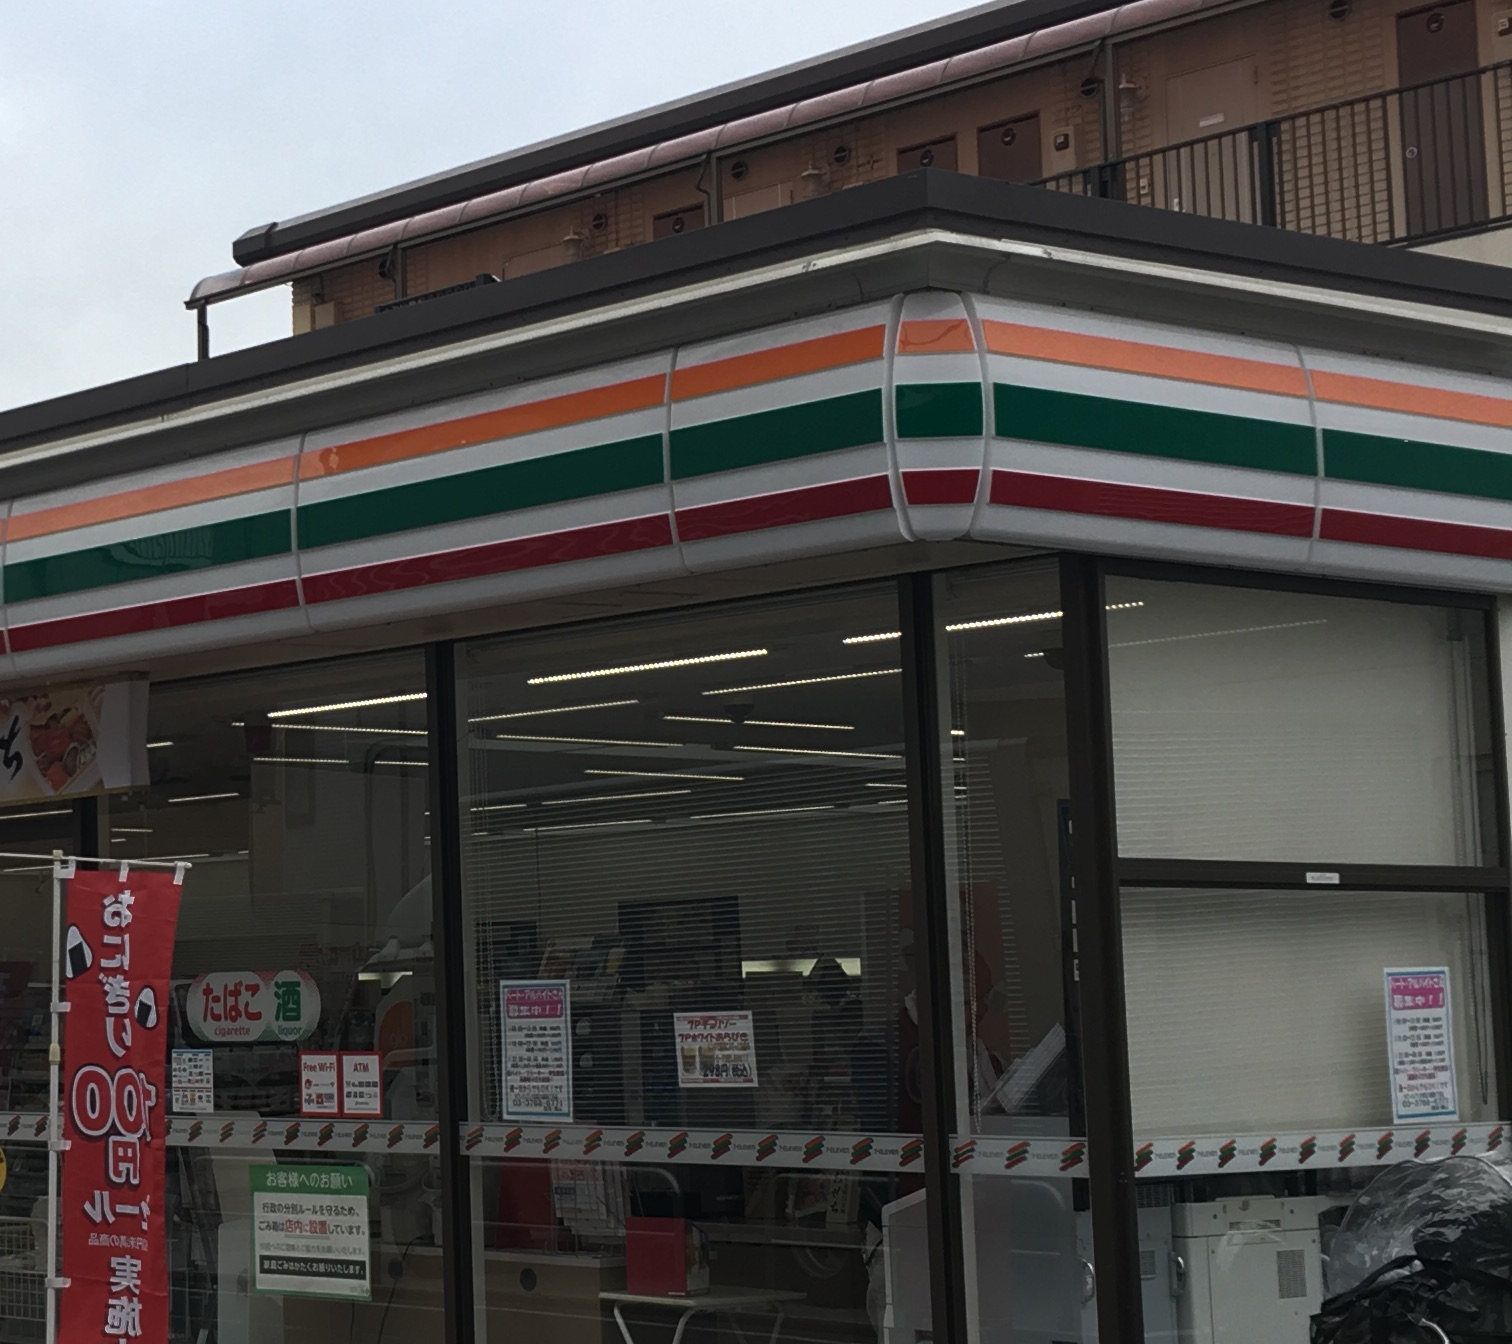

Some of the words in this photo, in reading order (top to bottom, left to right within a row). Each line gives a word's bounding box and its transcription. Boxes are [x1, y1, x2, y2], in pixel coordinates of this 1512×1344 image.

[203, 980, 262, 1023] たばこ
[274, 981, 301, 1022] 酒
[214, 1025, 251, 1036] cigarette
[277, 1025, 303, 1037] liquor
[353, 1063, 369, 1073] ATM
[266, 1171, 353, 1189] お客様へのお願い
